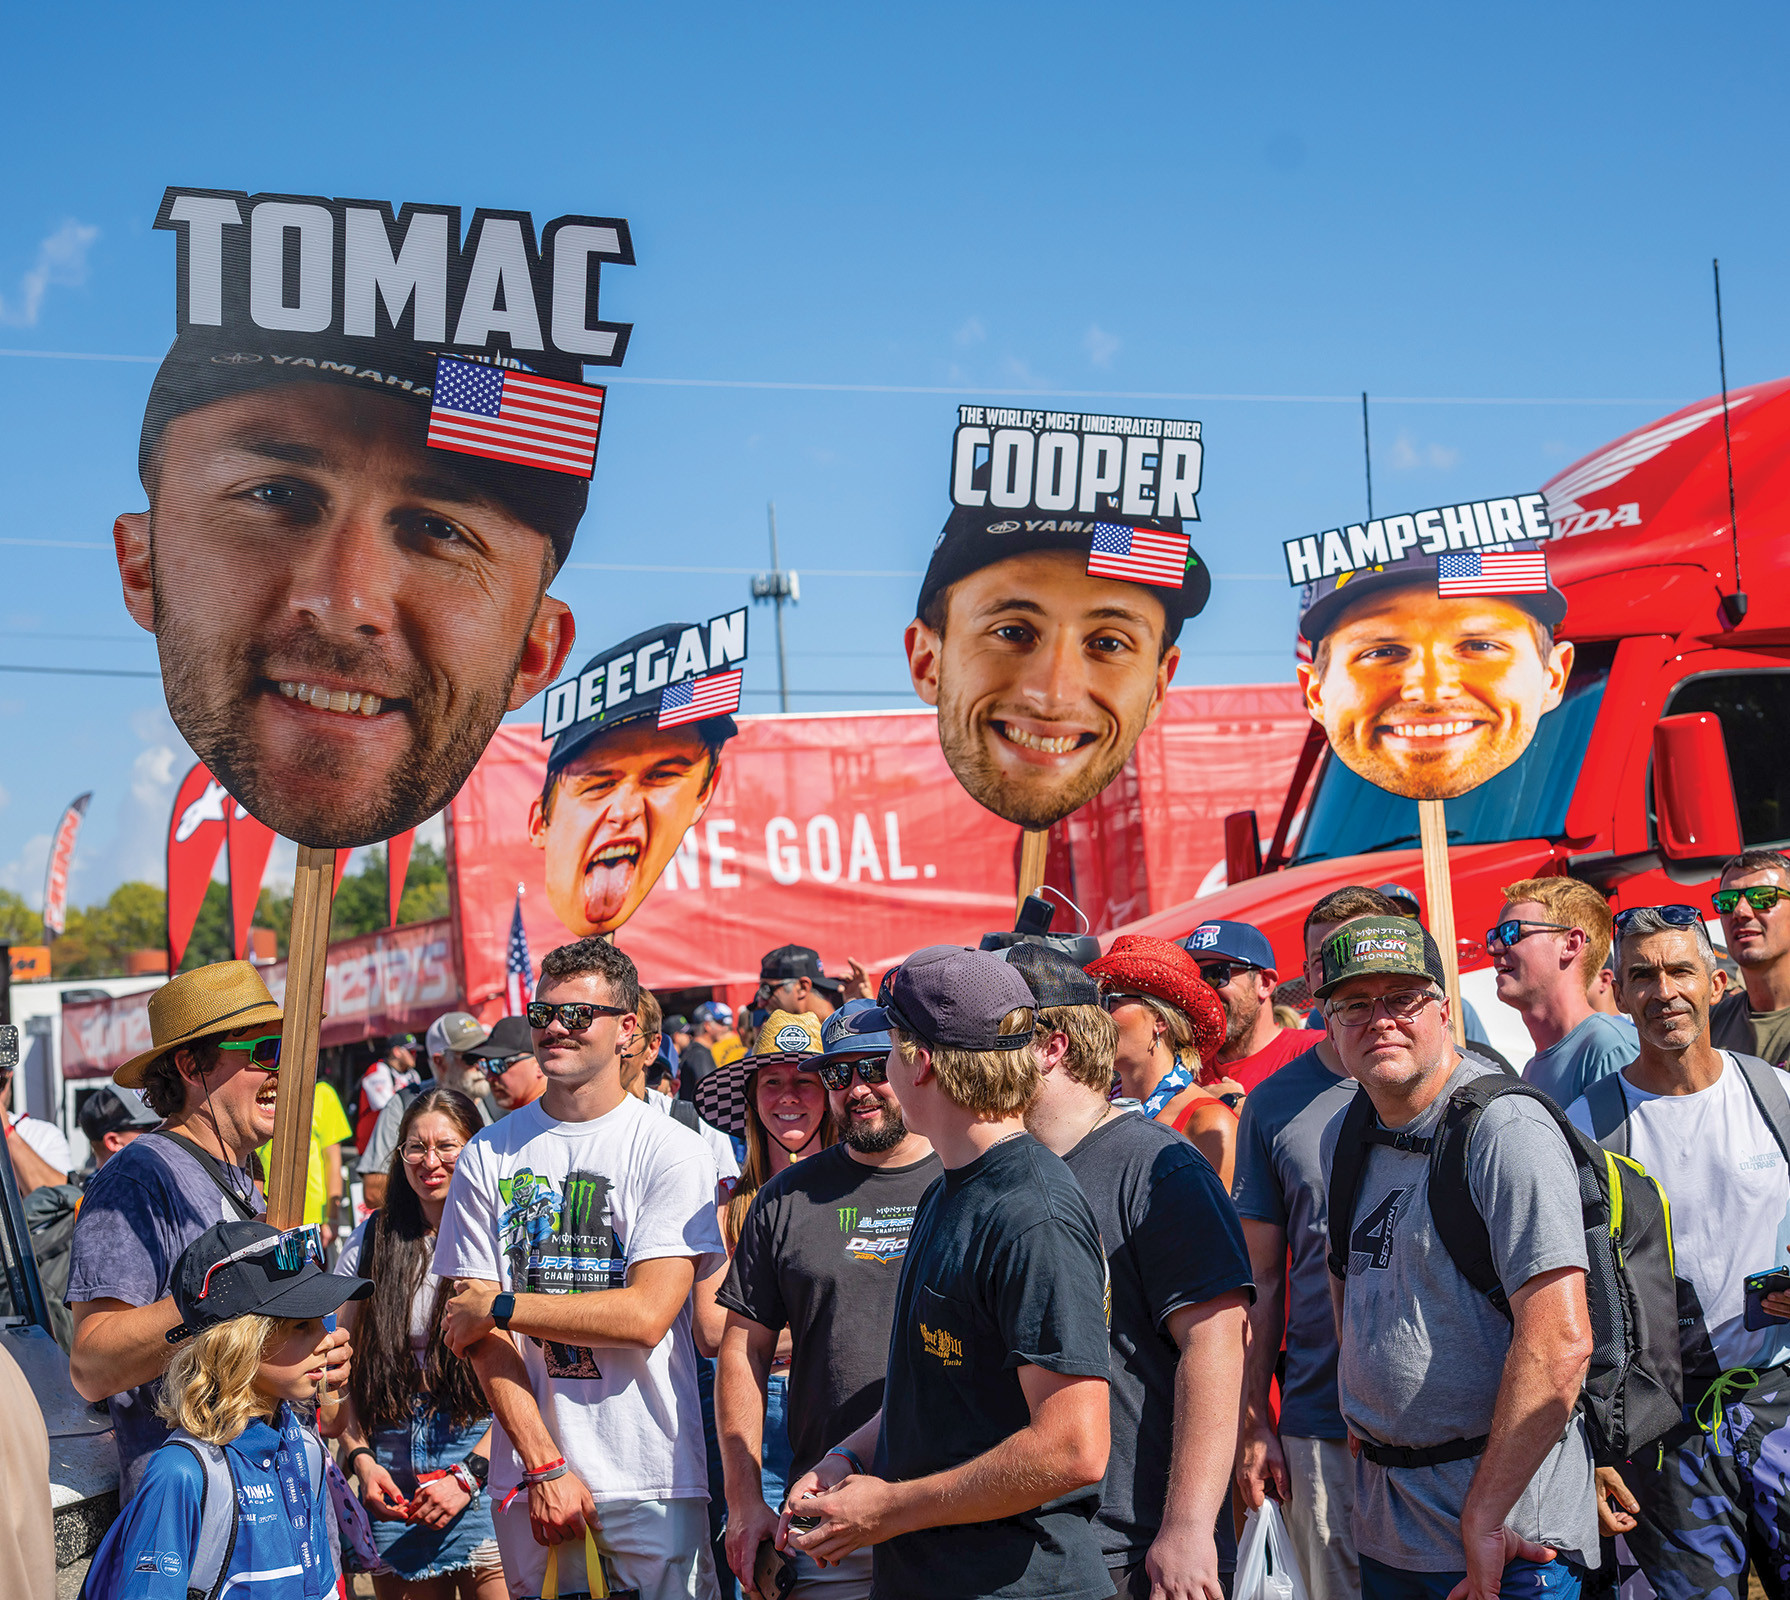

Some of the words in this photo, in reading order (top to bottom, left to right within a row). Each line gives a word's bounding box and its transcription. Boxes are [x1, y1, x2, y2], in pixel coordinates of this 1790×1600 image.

[169, 195, 622, 357] TOMAC
[270, 353, 432, 397] YAMAHA
[960, 406, 984, 425] THE
[986, 408, 1044, 430] WORLD'S
[1046, 412, 1081, 431] MOST
[1082, 414, 1162, 438] UNDERRATED
[1164, 420, 1201, 440] RIDER
[953, 427, 1202, 519] COOPER
[1025, 519, 1095, 534] YAMA
[1537, 502, 1642, 546] NDA
[1285, 494, 1552, 585] HAMPSHIRE
[545, 610, 747, 738] DEEGAN
[664, 819, 740, 891] NE
[765, 811, 937, 886] GOAL.
[1187, 932, 1215, 949] USA
[1356, 927, 1407, 938] MONSTER
[1356, 951, 1407, 963] IRONMAN
[858, 1217, 915, 1229] SUPERCR
[875, 1226, 912, 1235] CHAMPIONS
[1350, 1188, 1407, 1270] 4
[551, 1232, 608, 1248] MONSTER
[846, 1237, 909, 1252] DETRO
[1378, 1207, 1396, 1267] SEXTON
[525, 1255, 625, 1272] SUPERCROS
[544, 1271, 610, 1283] CHAMPIONSHIP
[1678, 1318, 1696, 1326] GHT
